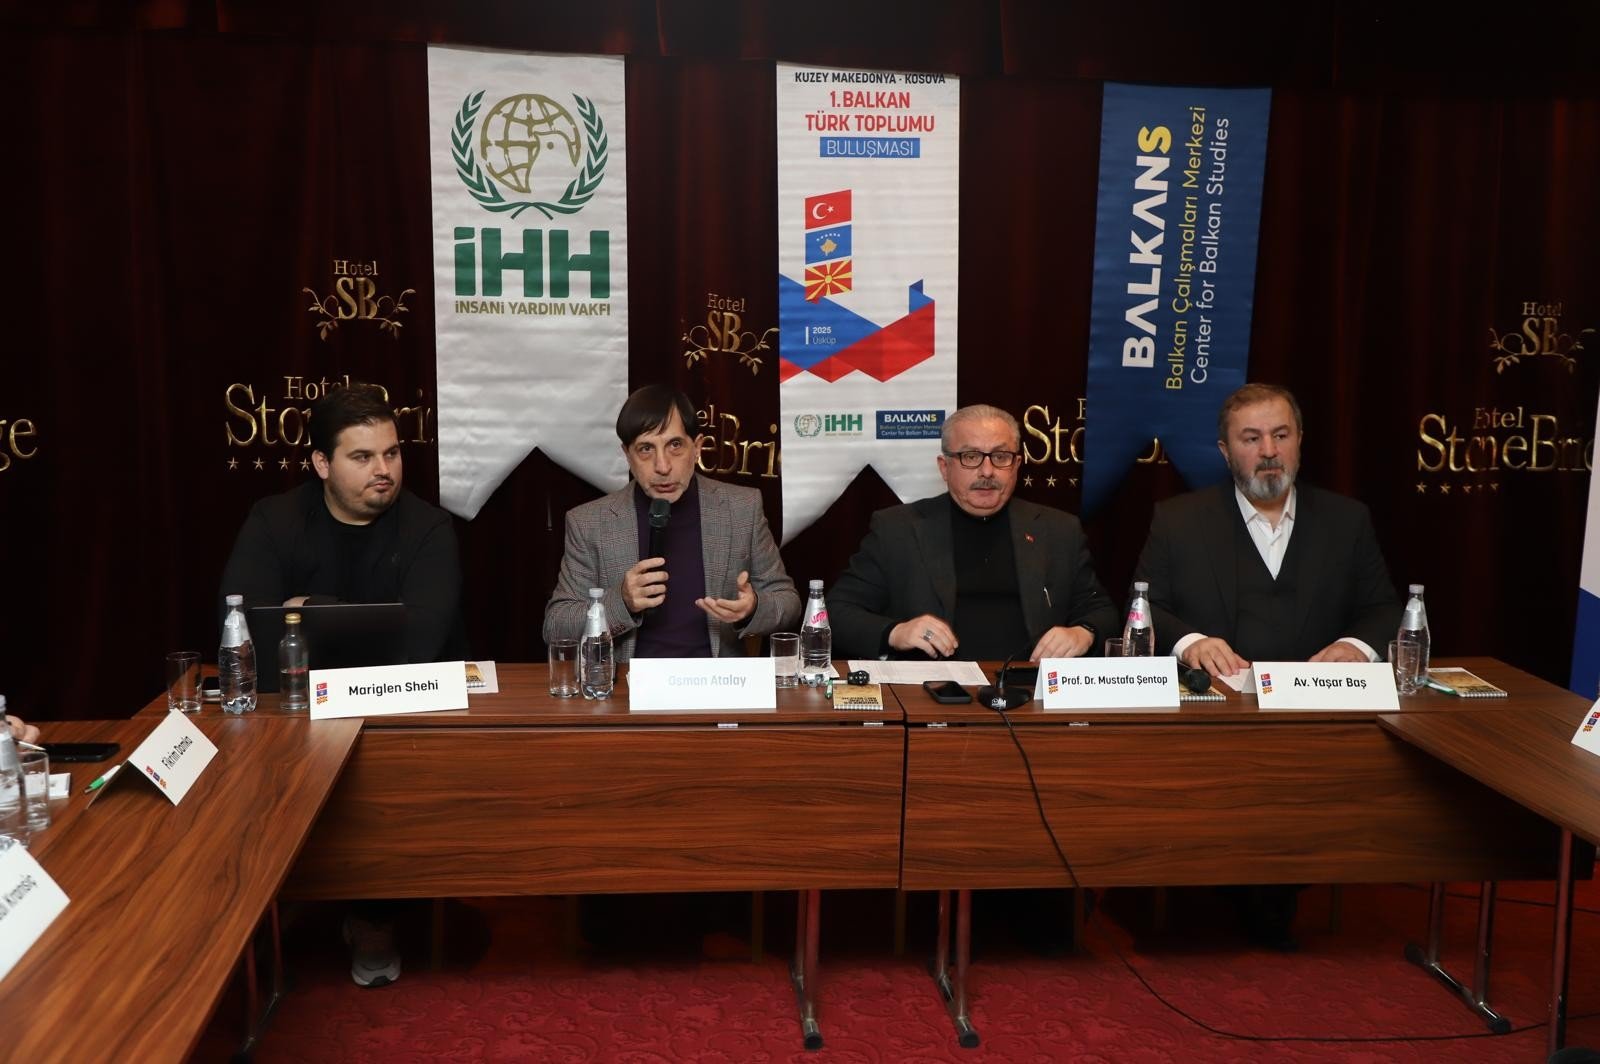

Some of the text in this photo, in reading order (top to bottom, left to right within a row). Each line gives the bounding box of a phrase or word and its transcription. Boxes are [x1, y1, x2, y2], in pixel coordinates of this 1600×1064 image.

[795, 72, 829, 83] KUZEY
[831, 72, 897, 84] MAKEDONYA
[905, 73, 946, 85] KOSOVA
[805, 110, 935, 132] TÜRK TOPLUMU
[827, 140, 913, 159] BULUŞMASI
[1121, 125, 1173, 368] BALKANS
[1166, 106, 1206, 390] Balkan Çalışmaları Merkezi
[1190, 117, 1230, 384] Center for Balkan Studies
[333, 259, 379, 276] Hotel
[335, 276, 378, 320] SB
[707, 293, 746, 313] Hotel
[509, 301, 566, 316] YARDIM
[569, 302, 611, 316] VAKFI
[707, 310, 742, 352] SB
[812, 326, 832, 334] 2025
[884, 413, 937, 423] BALKANS
[349, 680, 439, 697] Mariglen Shehi
[668, 674, 746, 687] Osman Atalay
[1061, 674, 1168, 687] Prof. Dr. Mustafa Şentop
[1294, 677, 1367, 689] Av. Yaşar Baş
